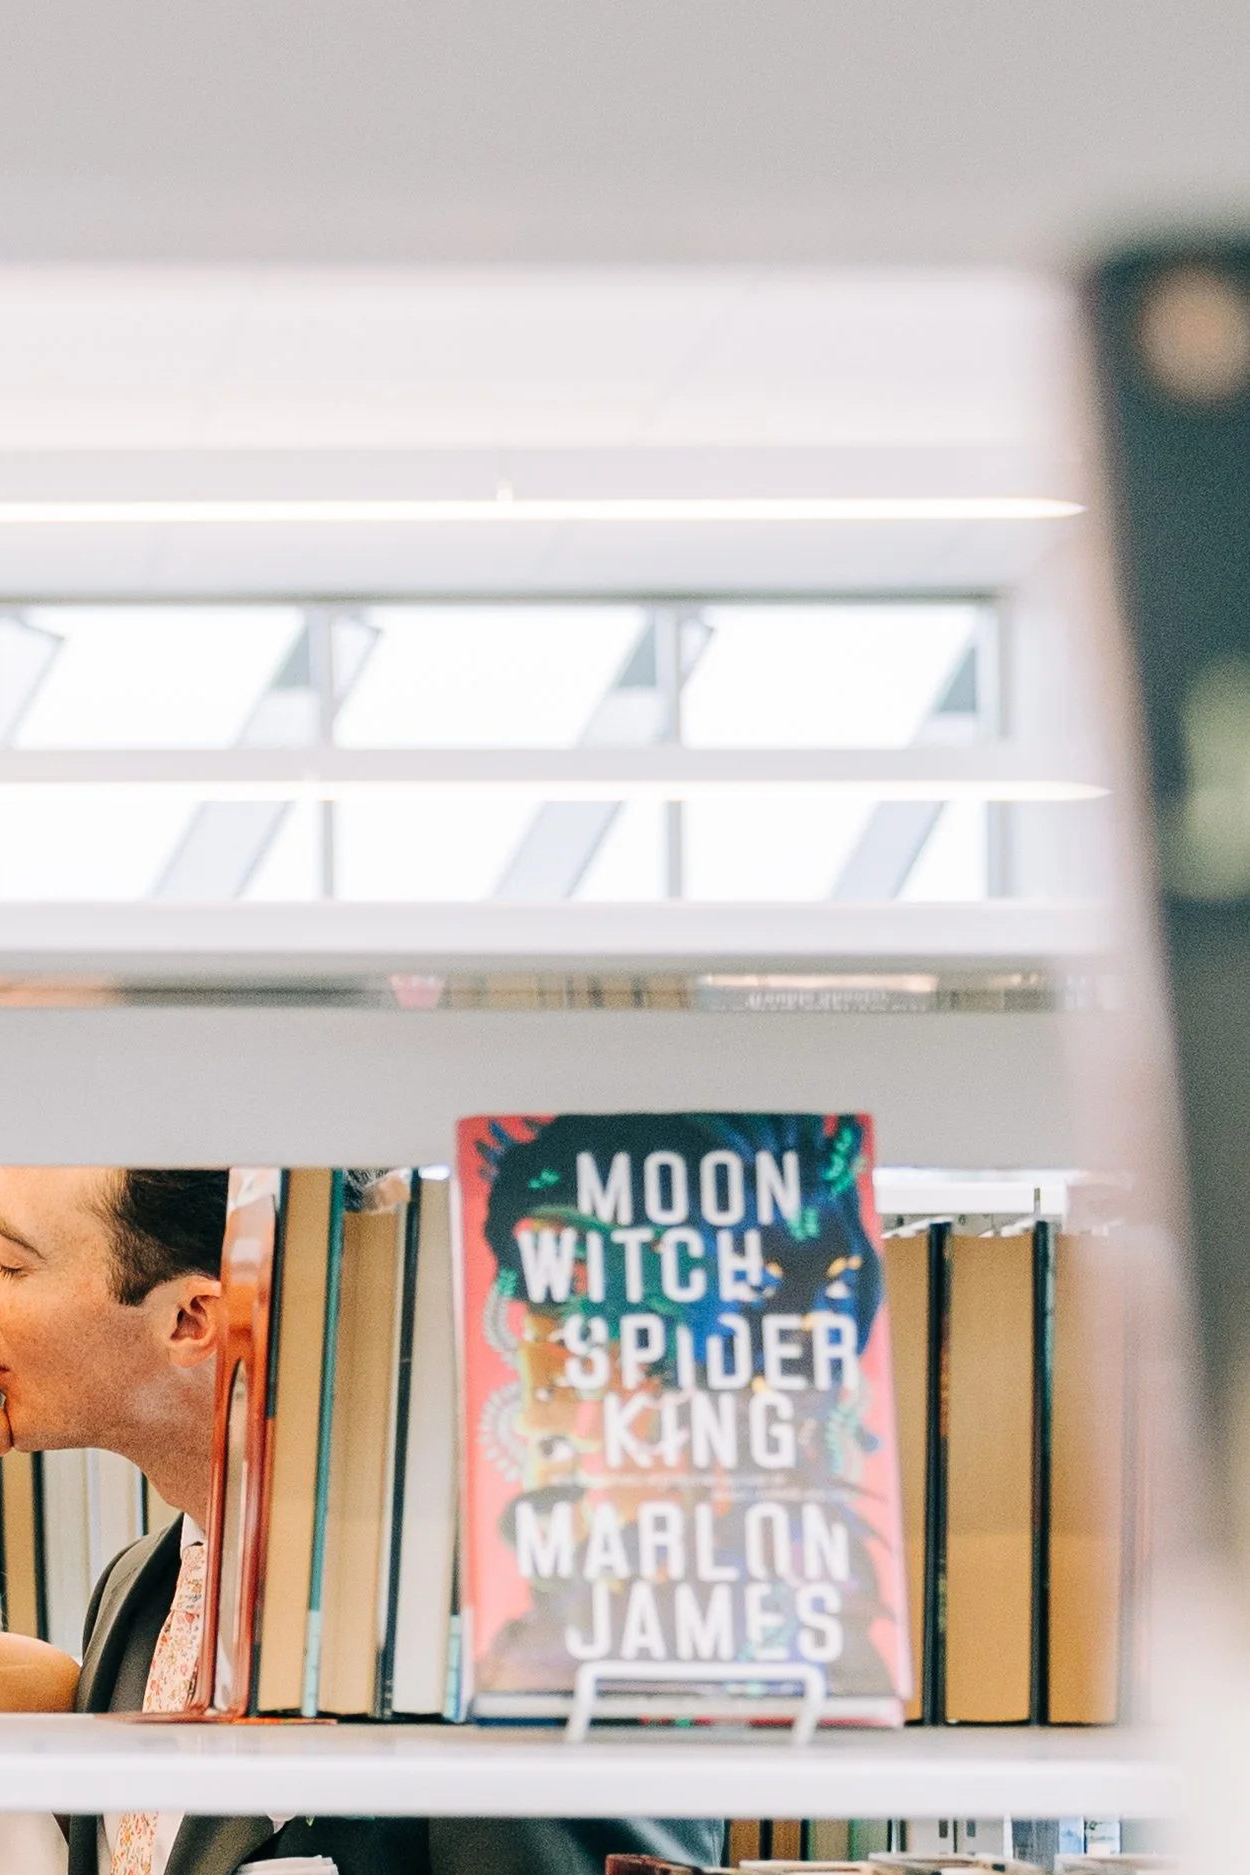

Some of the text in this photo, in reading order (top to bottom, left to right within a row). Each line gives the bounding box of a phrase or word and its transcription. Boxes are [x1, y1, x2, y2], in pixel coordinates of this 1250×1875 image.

[576, 1150, 802, 1226] MOON
[517, 1227, 763, 1304] WITCH
[562, 1313, 859, 1391] SPIDER
[603, 1392, 798, 1470] KING
[514, 1500, 850, 1582] MARLON
[564, 1583, 845, 1662] JAMES
